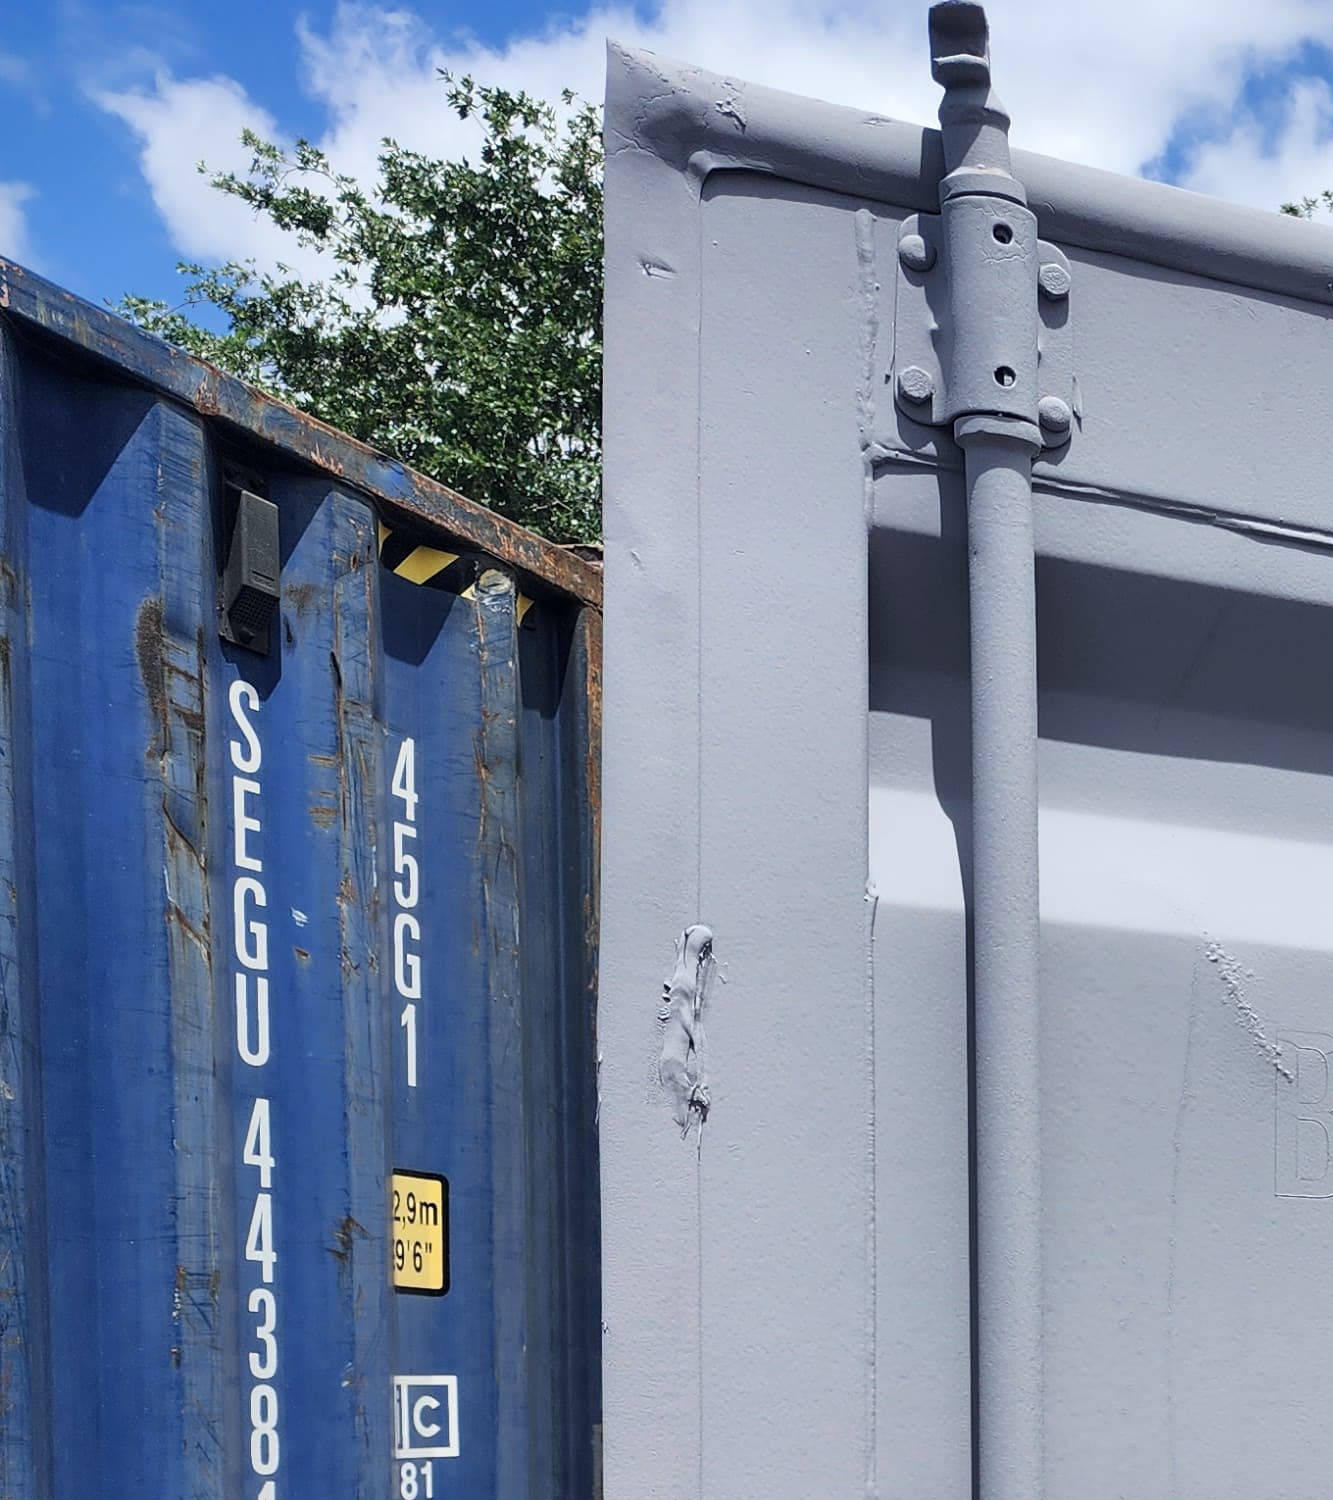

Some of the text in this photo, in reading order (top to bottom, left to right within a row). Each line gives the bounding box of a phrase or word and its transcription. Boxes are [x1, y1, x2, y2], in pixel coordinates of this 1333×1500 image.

[229, 679, 271, 1067] SEGU
[391, 737, 421, 1087] 45G1
[400, 1460, 433, 1500] 81
